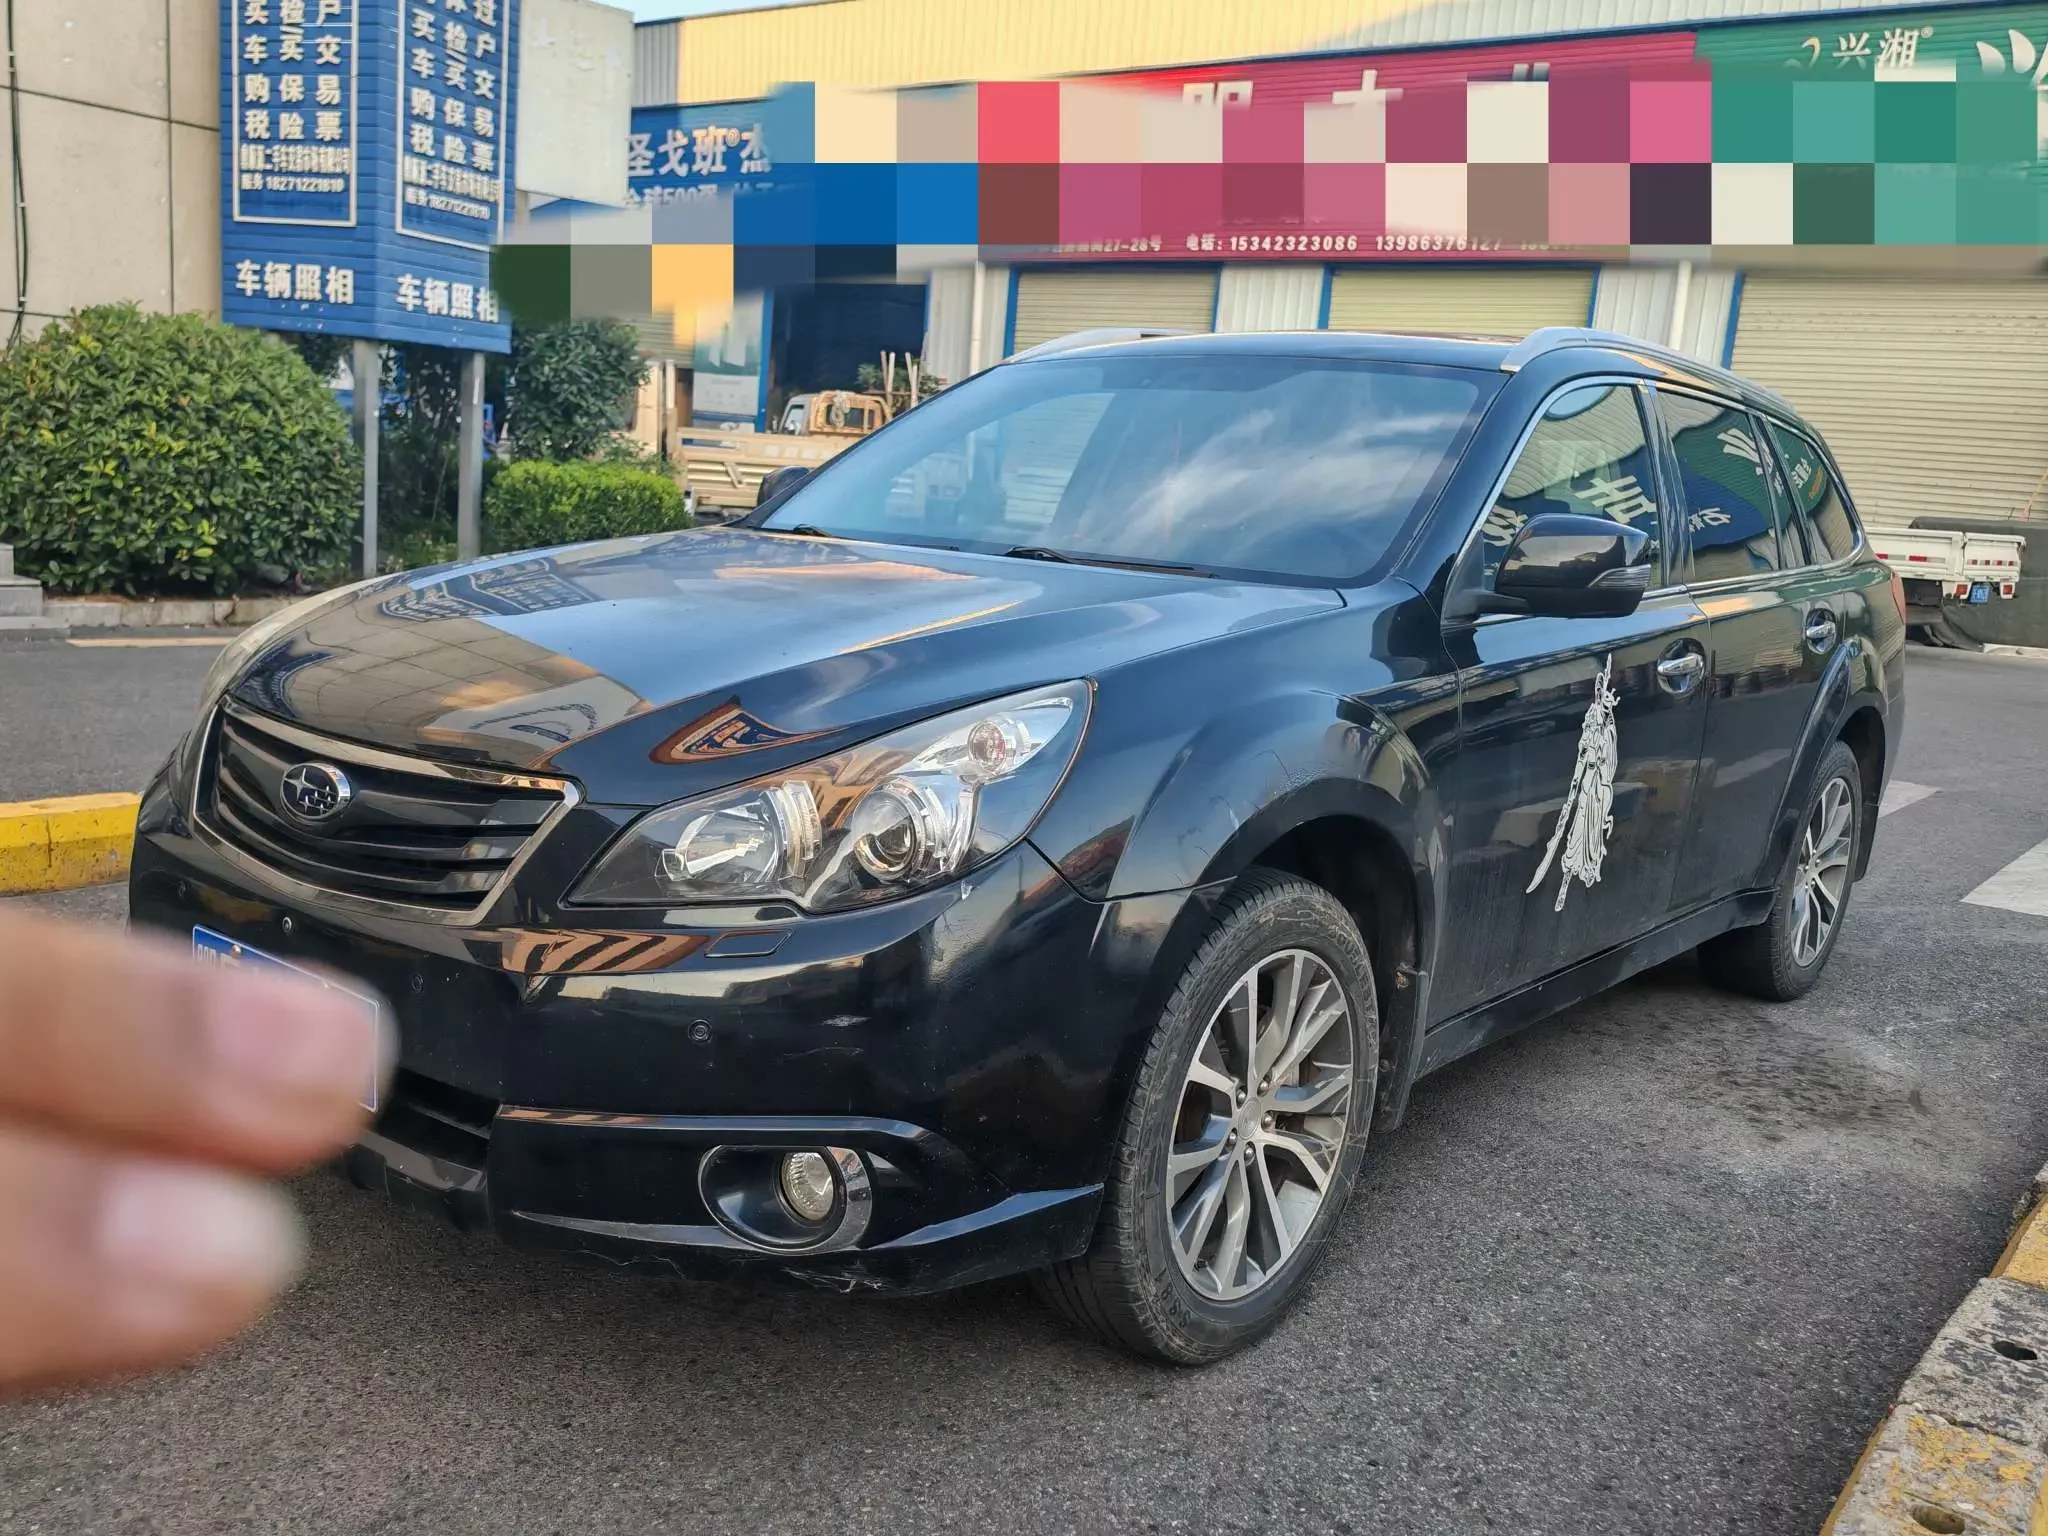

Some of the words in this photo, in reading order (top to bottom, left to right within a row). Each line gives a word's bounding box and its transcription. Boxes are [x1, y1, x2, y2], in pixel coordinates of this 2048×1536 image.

[235, 259, 354, 304] 车辆照相
[396, 273, 499, 323] 车辆照相
